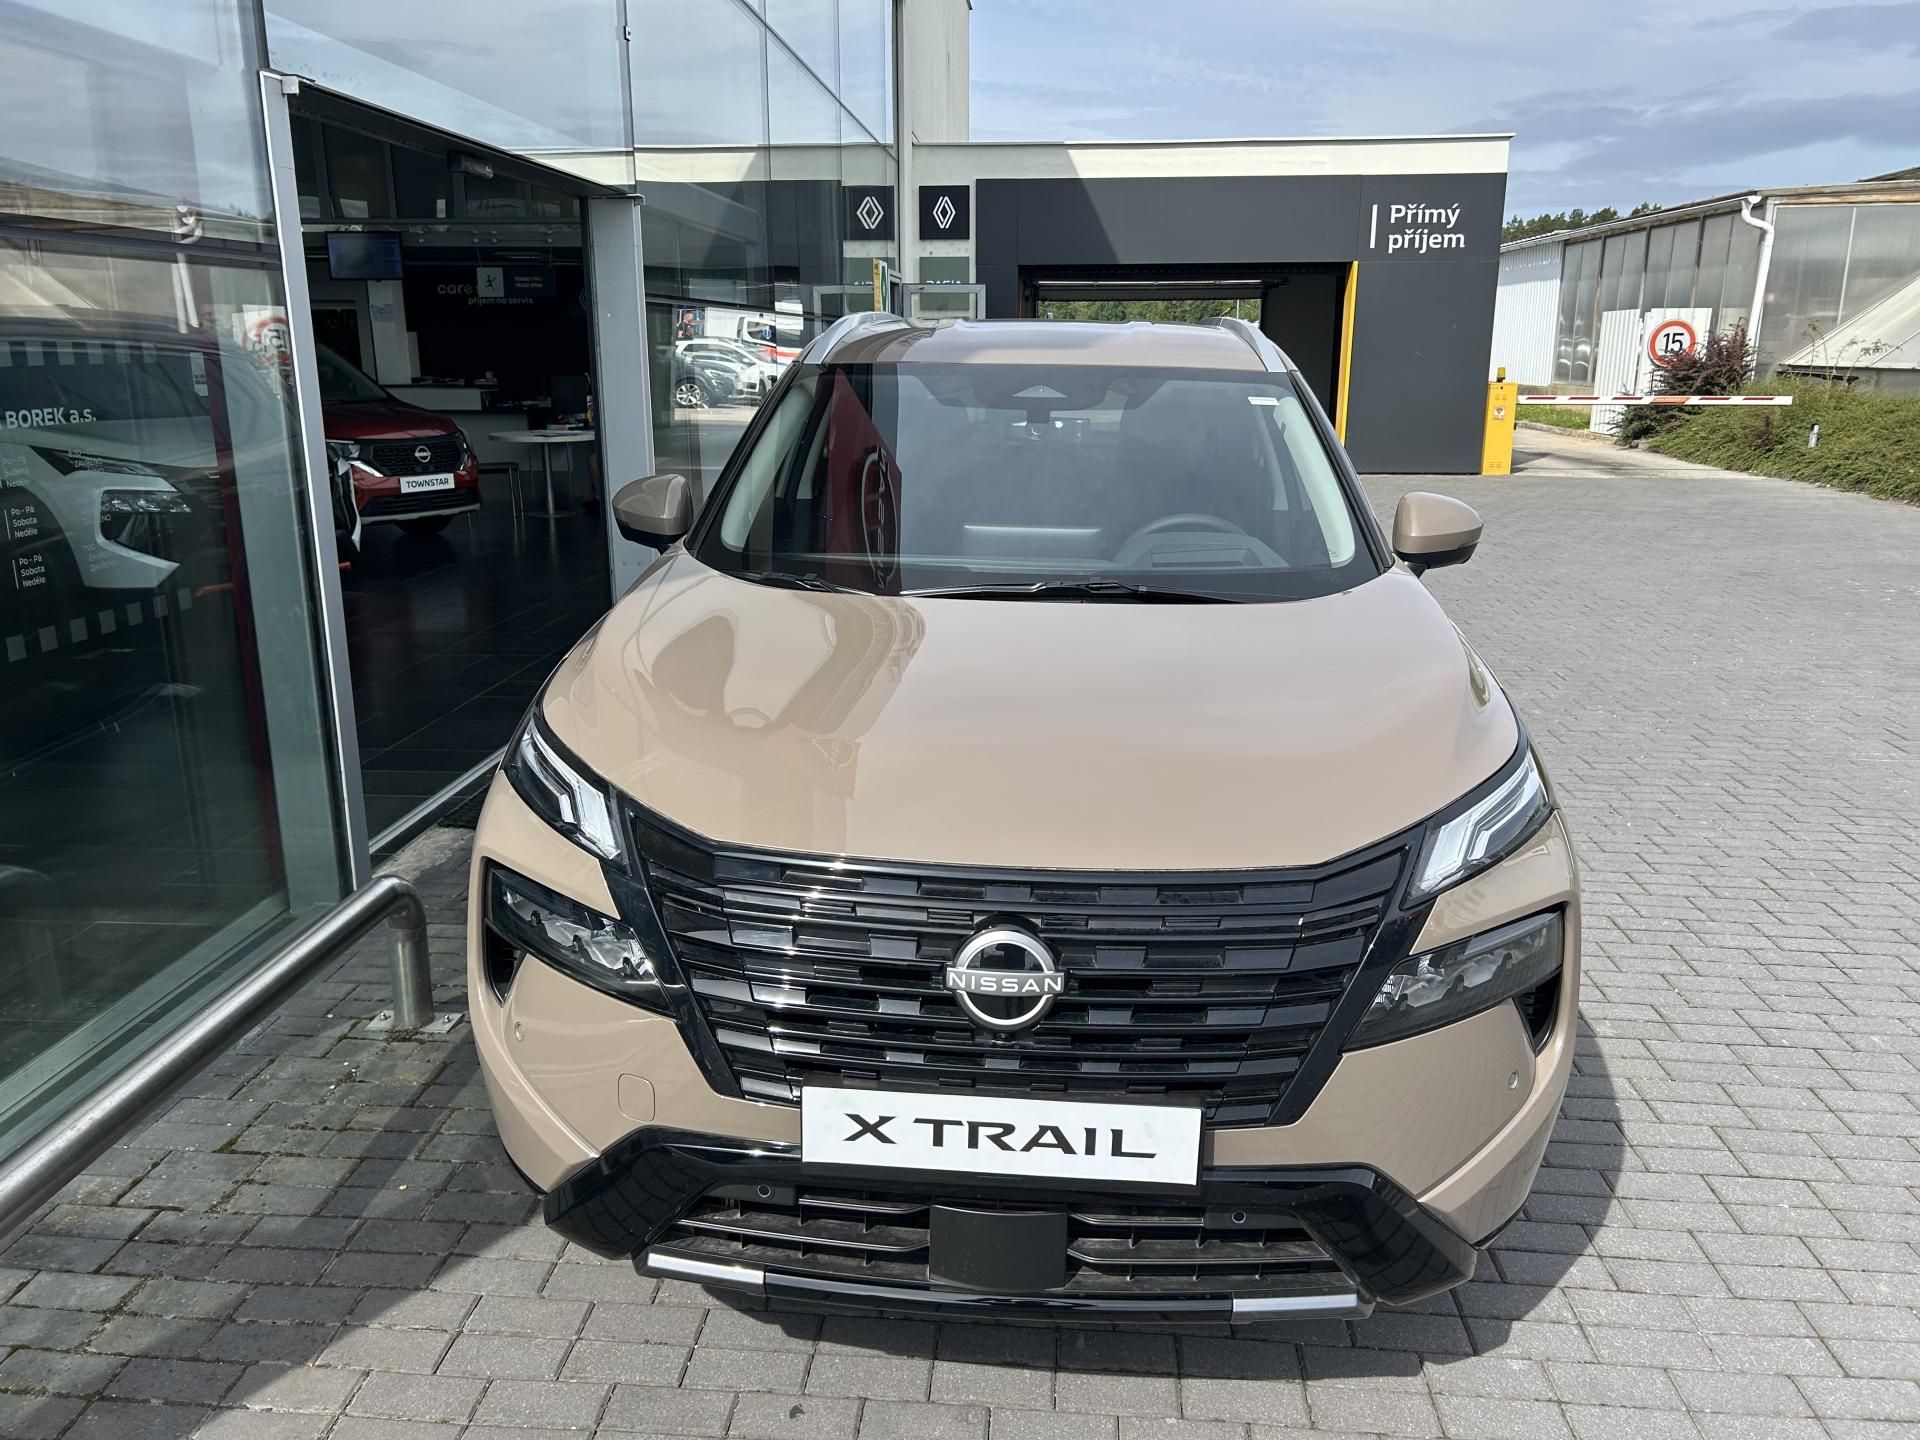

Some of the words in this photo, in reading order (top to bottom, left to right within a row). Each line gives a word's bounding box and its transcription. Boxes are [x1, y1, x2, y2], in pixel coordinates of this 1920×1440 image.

[1390, 203, 1461, 229] Přímý
[1388, 228, 1465, 254] příjem
[437, 283, 473, 295] care
[1663, 332, 1685, 354] 15
[5, 406, 66, 429] BOREK
[69, 407, 97, 424] a.s.
[405, 477, 450, 489] TOWNSTAR
[10, 507, 20, 516] Po
[12, 516, 38, 528] Sobota
[18, 557, 29, 567] Po
[20, 565, 45, 577] Sobota
[948, 972, 1063, 993] NISSAN
[842, 1112, 898, 1145] X
[913, 1116, 1157, 1159] TRAIL
